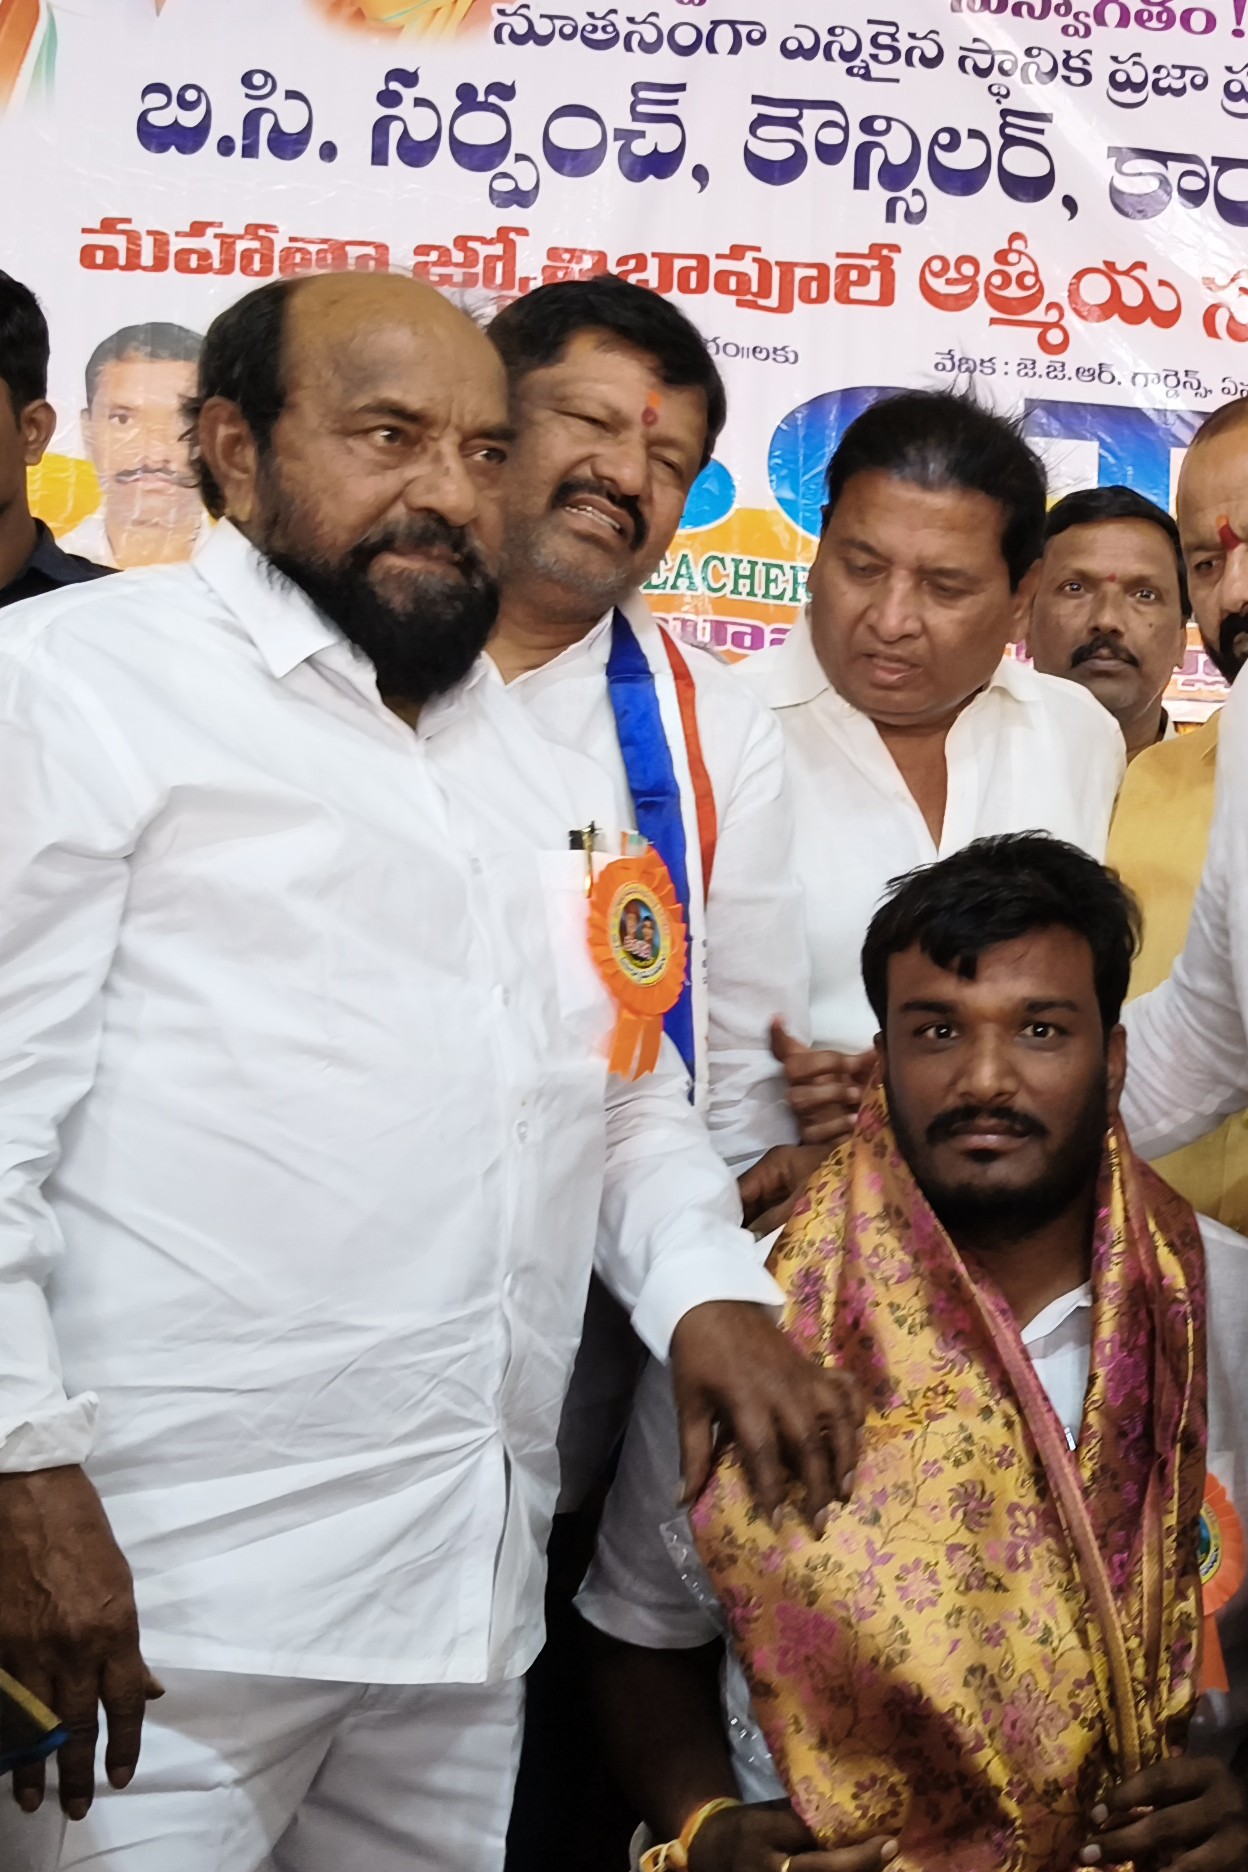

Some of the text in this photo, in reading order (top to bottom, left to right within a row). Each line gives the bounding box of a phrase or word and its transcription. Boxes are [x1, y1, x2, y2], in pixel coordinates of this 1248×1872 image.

[493, 4, 767, 57] నూతనంగా
[780, 19, 945, 83] ఎన్నికైన
[1106, 53, 1209, 109] ప్రజా
[136, 68, 338, 163] బి.సి.
[370, 66, 710, 209] సర్పంచ్,
[744, 93, 1079, 225] కౌన్సిలర్,
[918, 231, 1182, 357] ఆత్మీయ
[934, 350, 997, 376] వేదిక
